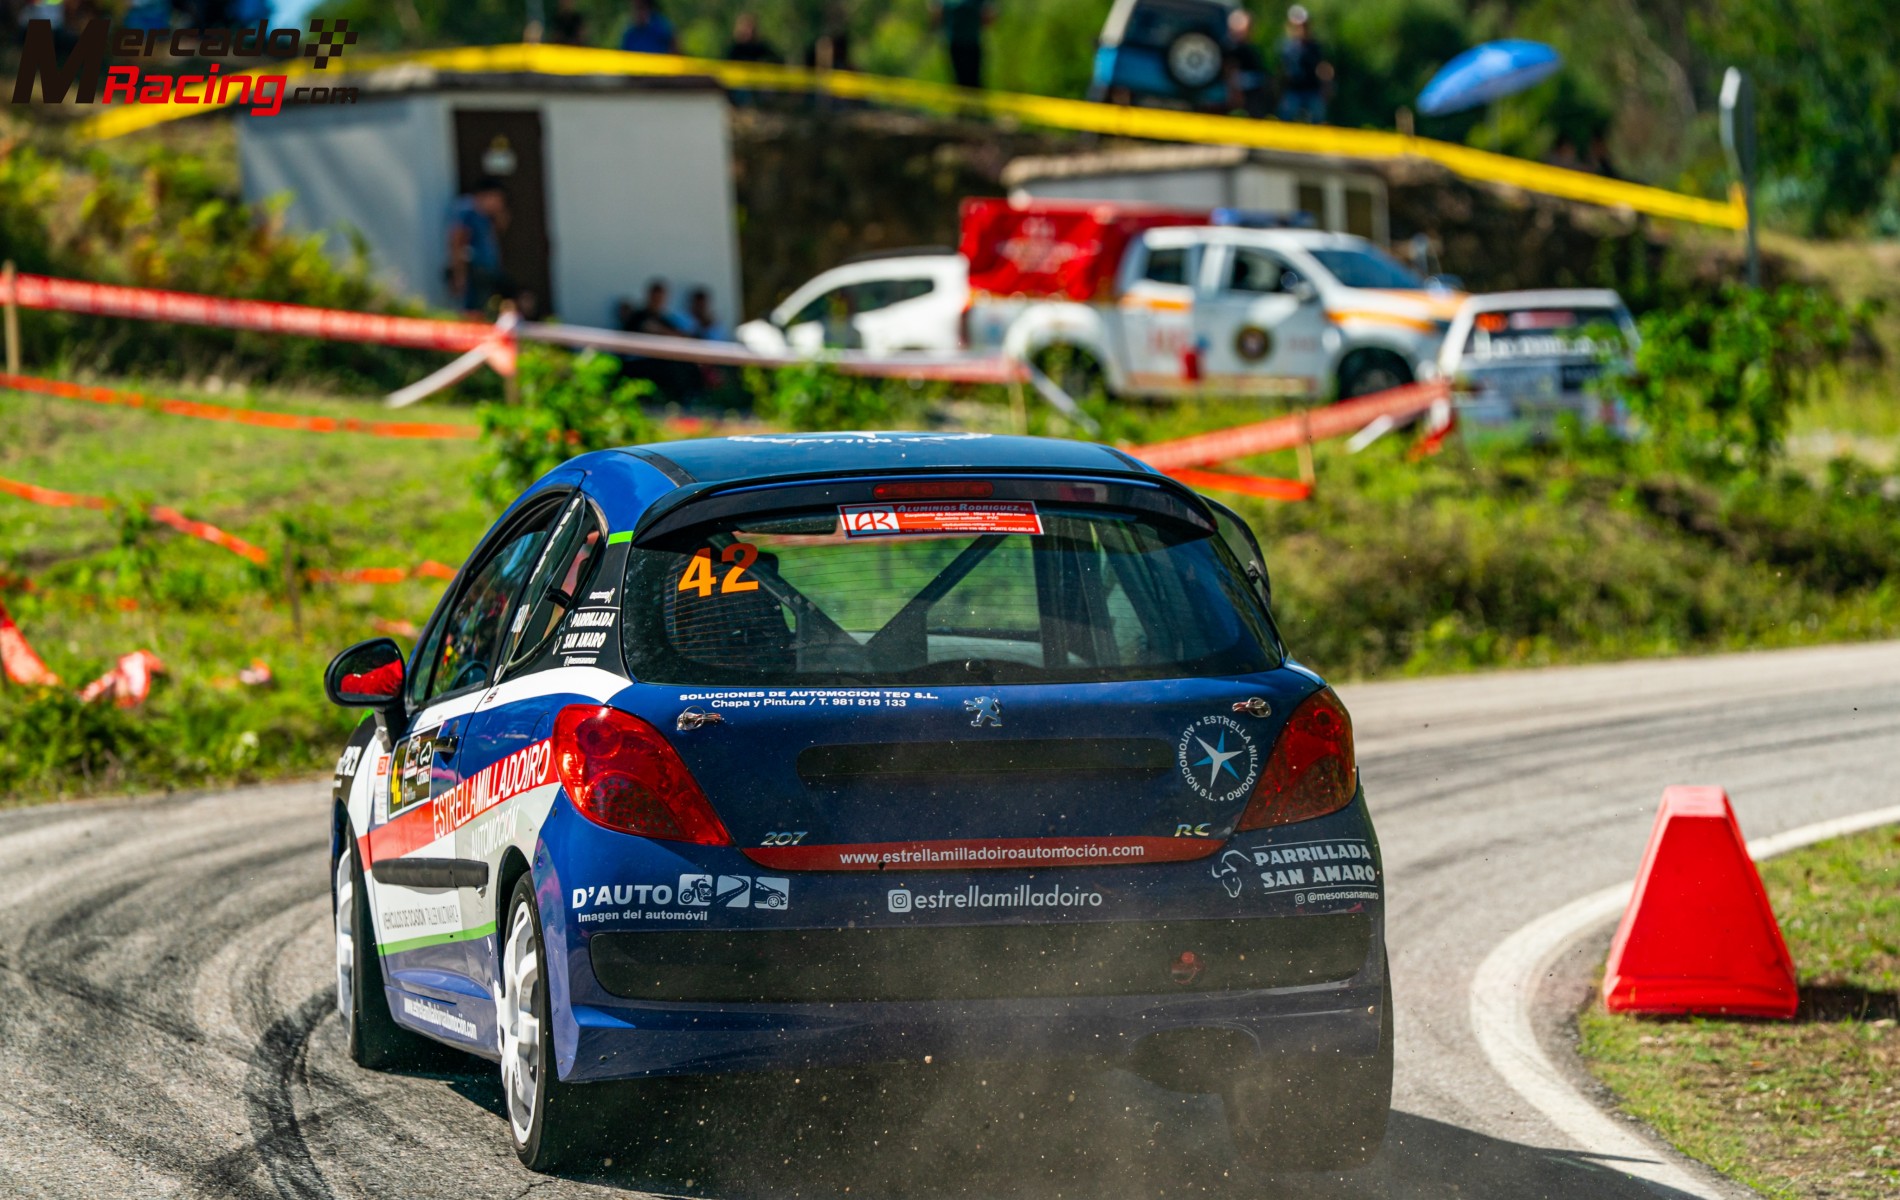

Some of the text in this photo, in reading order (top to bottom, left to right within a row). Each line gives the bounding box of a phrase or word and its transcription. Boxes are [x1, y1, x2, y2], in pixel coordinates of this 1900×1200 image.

[678, 543, 759, 597] 42
[562, 633, 580, 649] SAN
[680, 691, 765, 701] SOLUCIONES
[789, 690, 881, 698] AUTOMOCION
[884, 691, 911, 699] TEO
[711, 698, 907, 709] Chapa y Pintura / T. 981 819 133
[1178, 724, 1217, 801] AUTOMOCIÓN S.L.
[1203, 715, 1259, 801] ESTRELLA MILLADOIRO
[433, 740, 551, 840] ESTRELLAMILLADOIRO
[760, 831, 809, 846] 207
[1174, 823, 1212, 837] RC
[840, 844, 1145, 863] www.estrellamilladoiroautomoción.com
[1253, 844, 1371, 866] PARRILLADA
[1260, 864, 1376, 888] SAN AMARO
[572, 884, 673, 909] D'AUTO
[914, 884, 1103, 909] estrellamilladoiro
[1307, 891, 1379, 901] @mesonsanamaro
[578, 909, 708, 923] Imagen del automóvil
